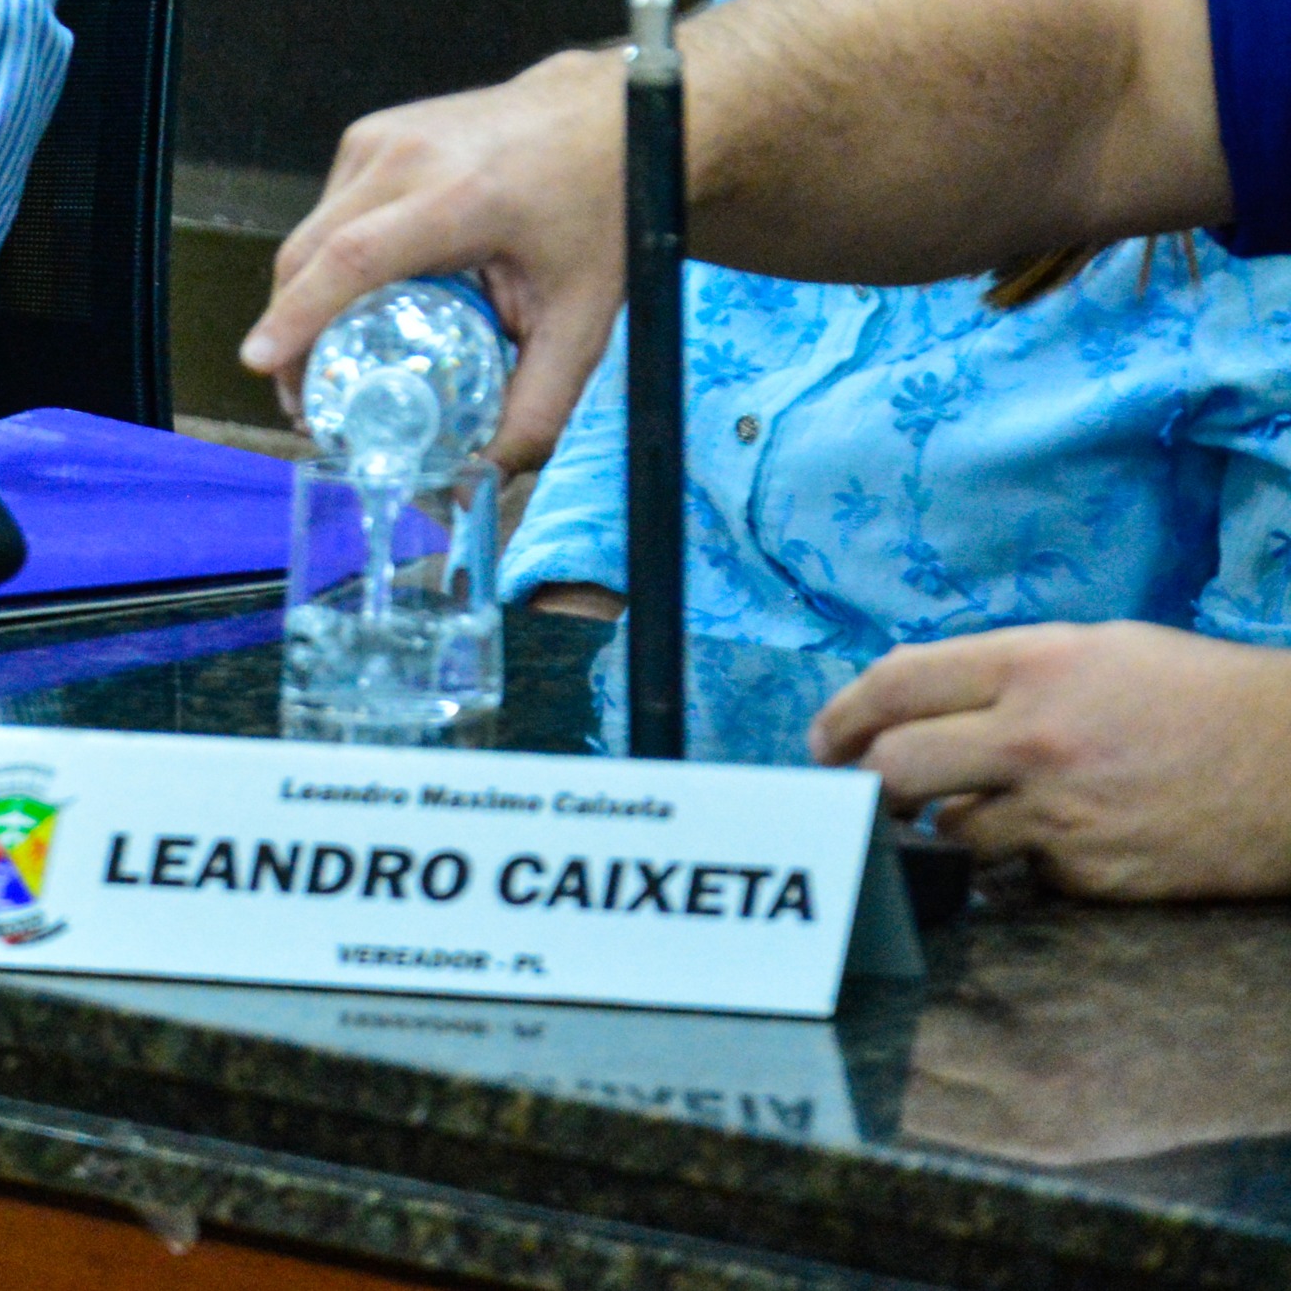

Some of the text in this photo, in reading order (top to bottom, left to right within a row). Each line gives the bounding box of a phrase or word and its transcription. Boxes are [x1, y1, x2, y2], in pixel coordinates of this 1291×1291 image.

[279, 776, 410, 805] Leandro
[551, 789, 677, 821] Caixeta
[101, 831, 820, 923] LEANDRO CAIXETA
[337, 942, 492, 971] VEREADOR
[511, 951, 548, 979] PL
